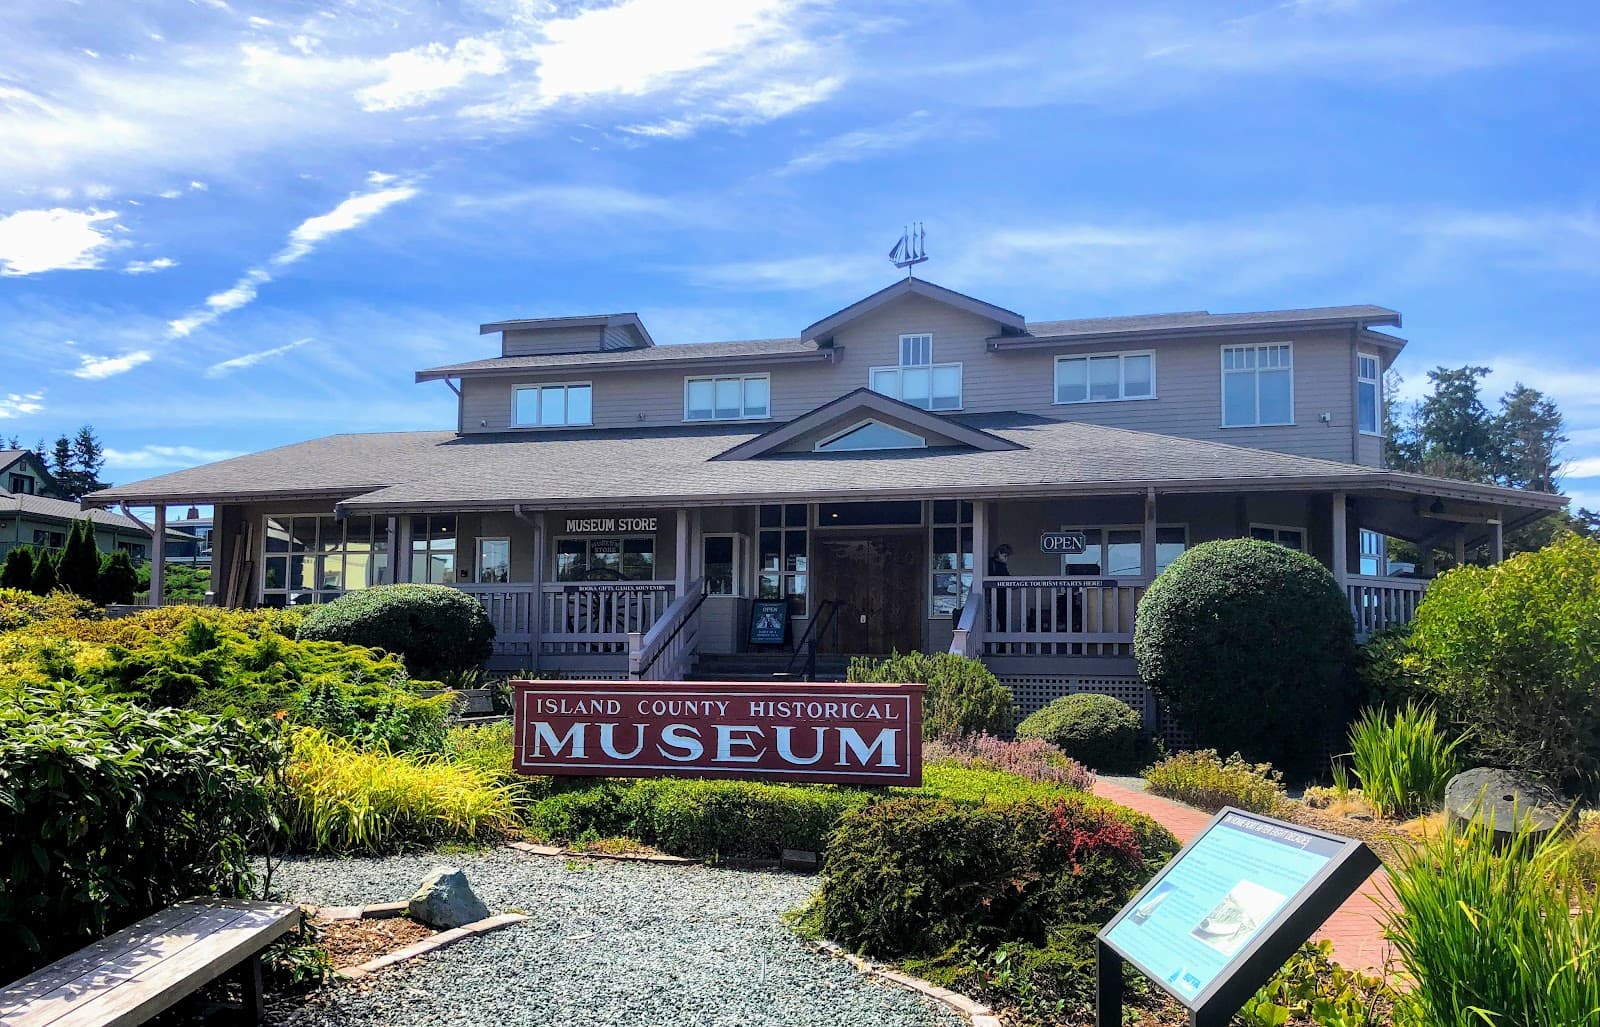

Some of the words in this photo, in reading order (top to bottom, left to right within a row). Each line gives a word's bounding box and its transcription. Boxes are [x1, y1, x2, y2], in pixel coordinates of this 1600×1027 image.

[566, 519, 615, 532] MUSEUM
[618, 518, 657, 531] STORE
[1043, 536, 1082, 550] OPEN
[536, 698, 621, 715] ISLAND
[637, 700, 730, 716] COUNTY
[750, 701, 899, 720] HISTORICAL
[529, 721, 902, 767] MUSEUM
